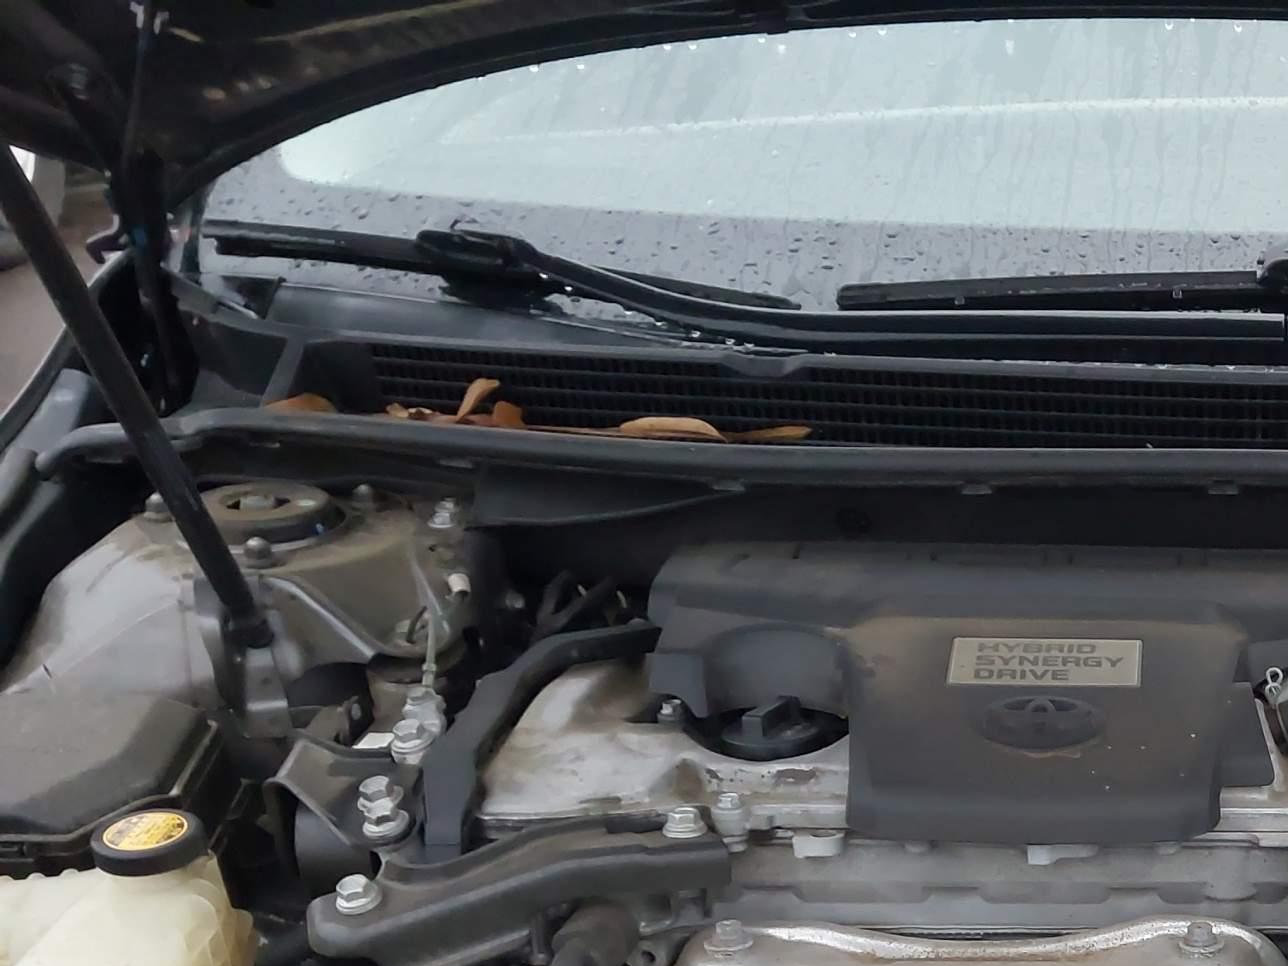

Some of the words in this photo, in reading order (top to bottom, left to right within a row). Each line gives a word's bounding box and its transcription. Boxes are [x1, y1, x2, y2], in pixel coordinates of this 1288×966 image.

[977, 642, 1097, 654] HYBRID
[975, 655, 1125, 668] SYNERGY
[973, 668, 1070, 681] DRIVE
